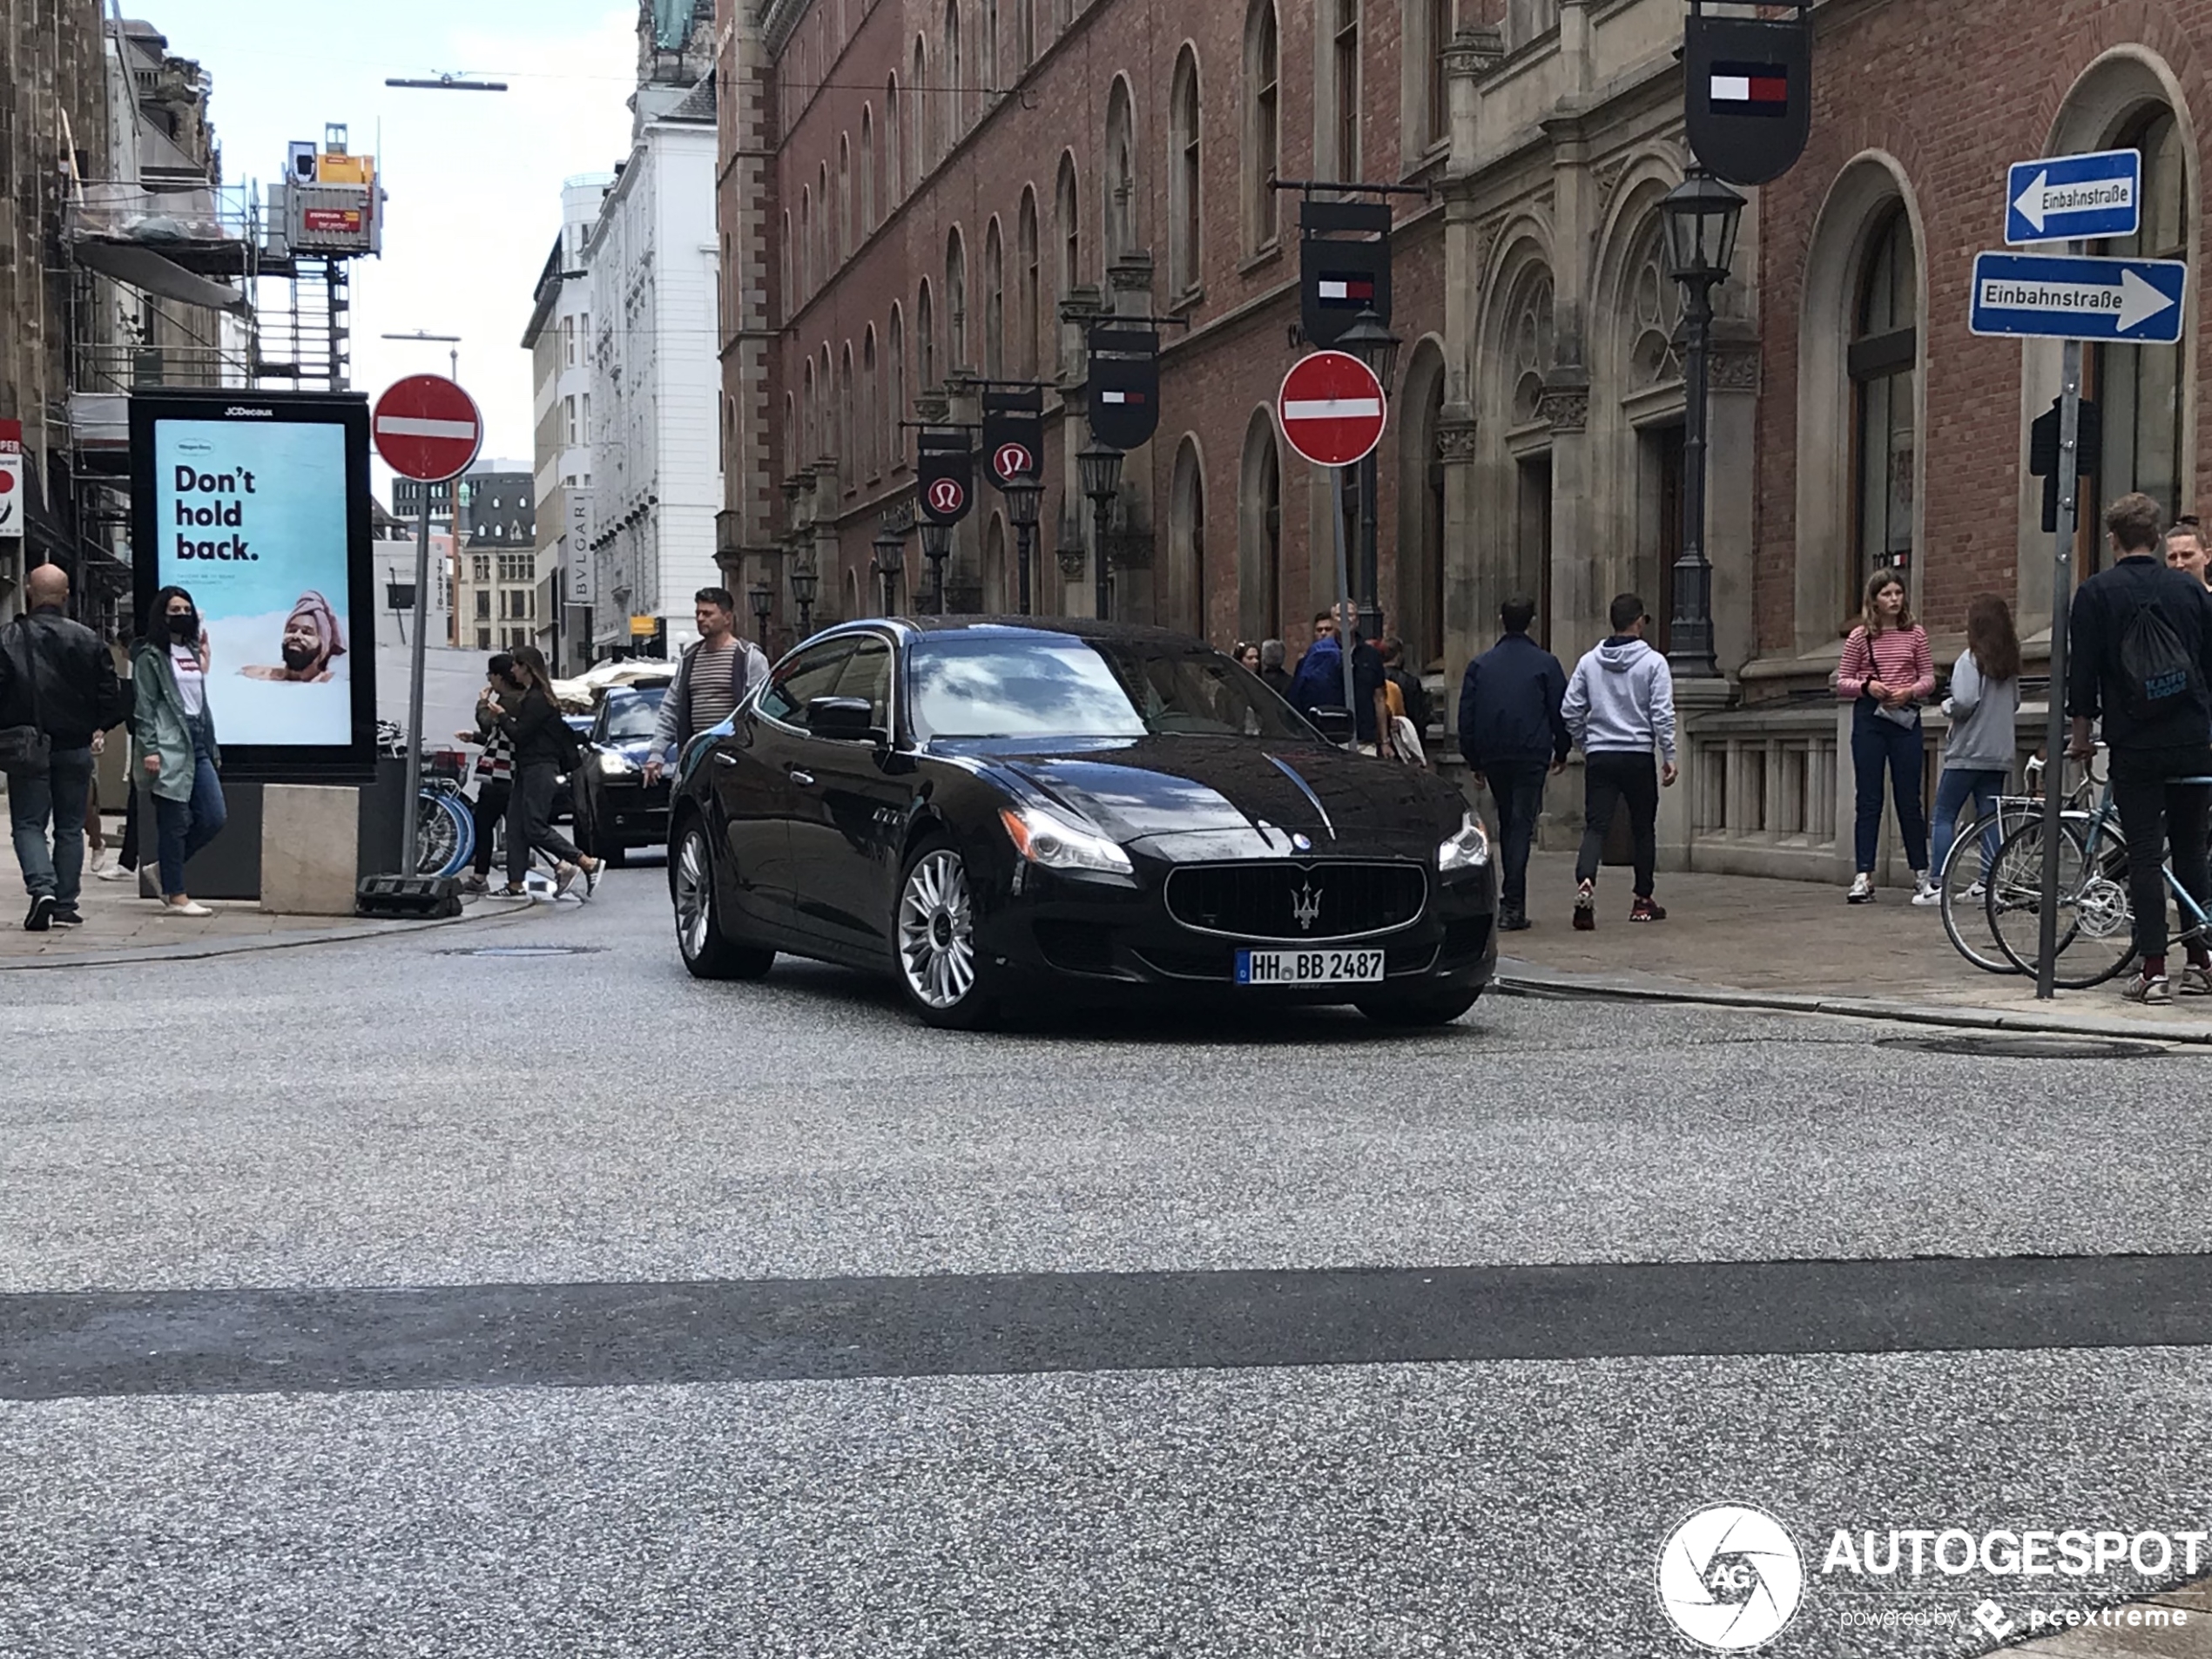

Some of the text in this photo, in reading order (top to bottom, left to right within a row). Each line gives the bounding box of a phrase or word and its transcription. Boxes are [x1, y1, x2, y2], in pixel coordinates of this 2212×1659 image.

[2042, 185, 2128, 209] Einbahnstraße
[1986, 285, 2122, 308] Einbahnstraße
[224, 406, 273, 416] JCDecaux
[176, 499, 242, 527] hold
[177, 533, 260, 561] back.
[574, 496, 587, 594] BVLGARI
[1252, 954, 1280, 980] HH
[1297, 954, 1324, 979] BB
[1330, 952, 1383, 978] 2487
